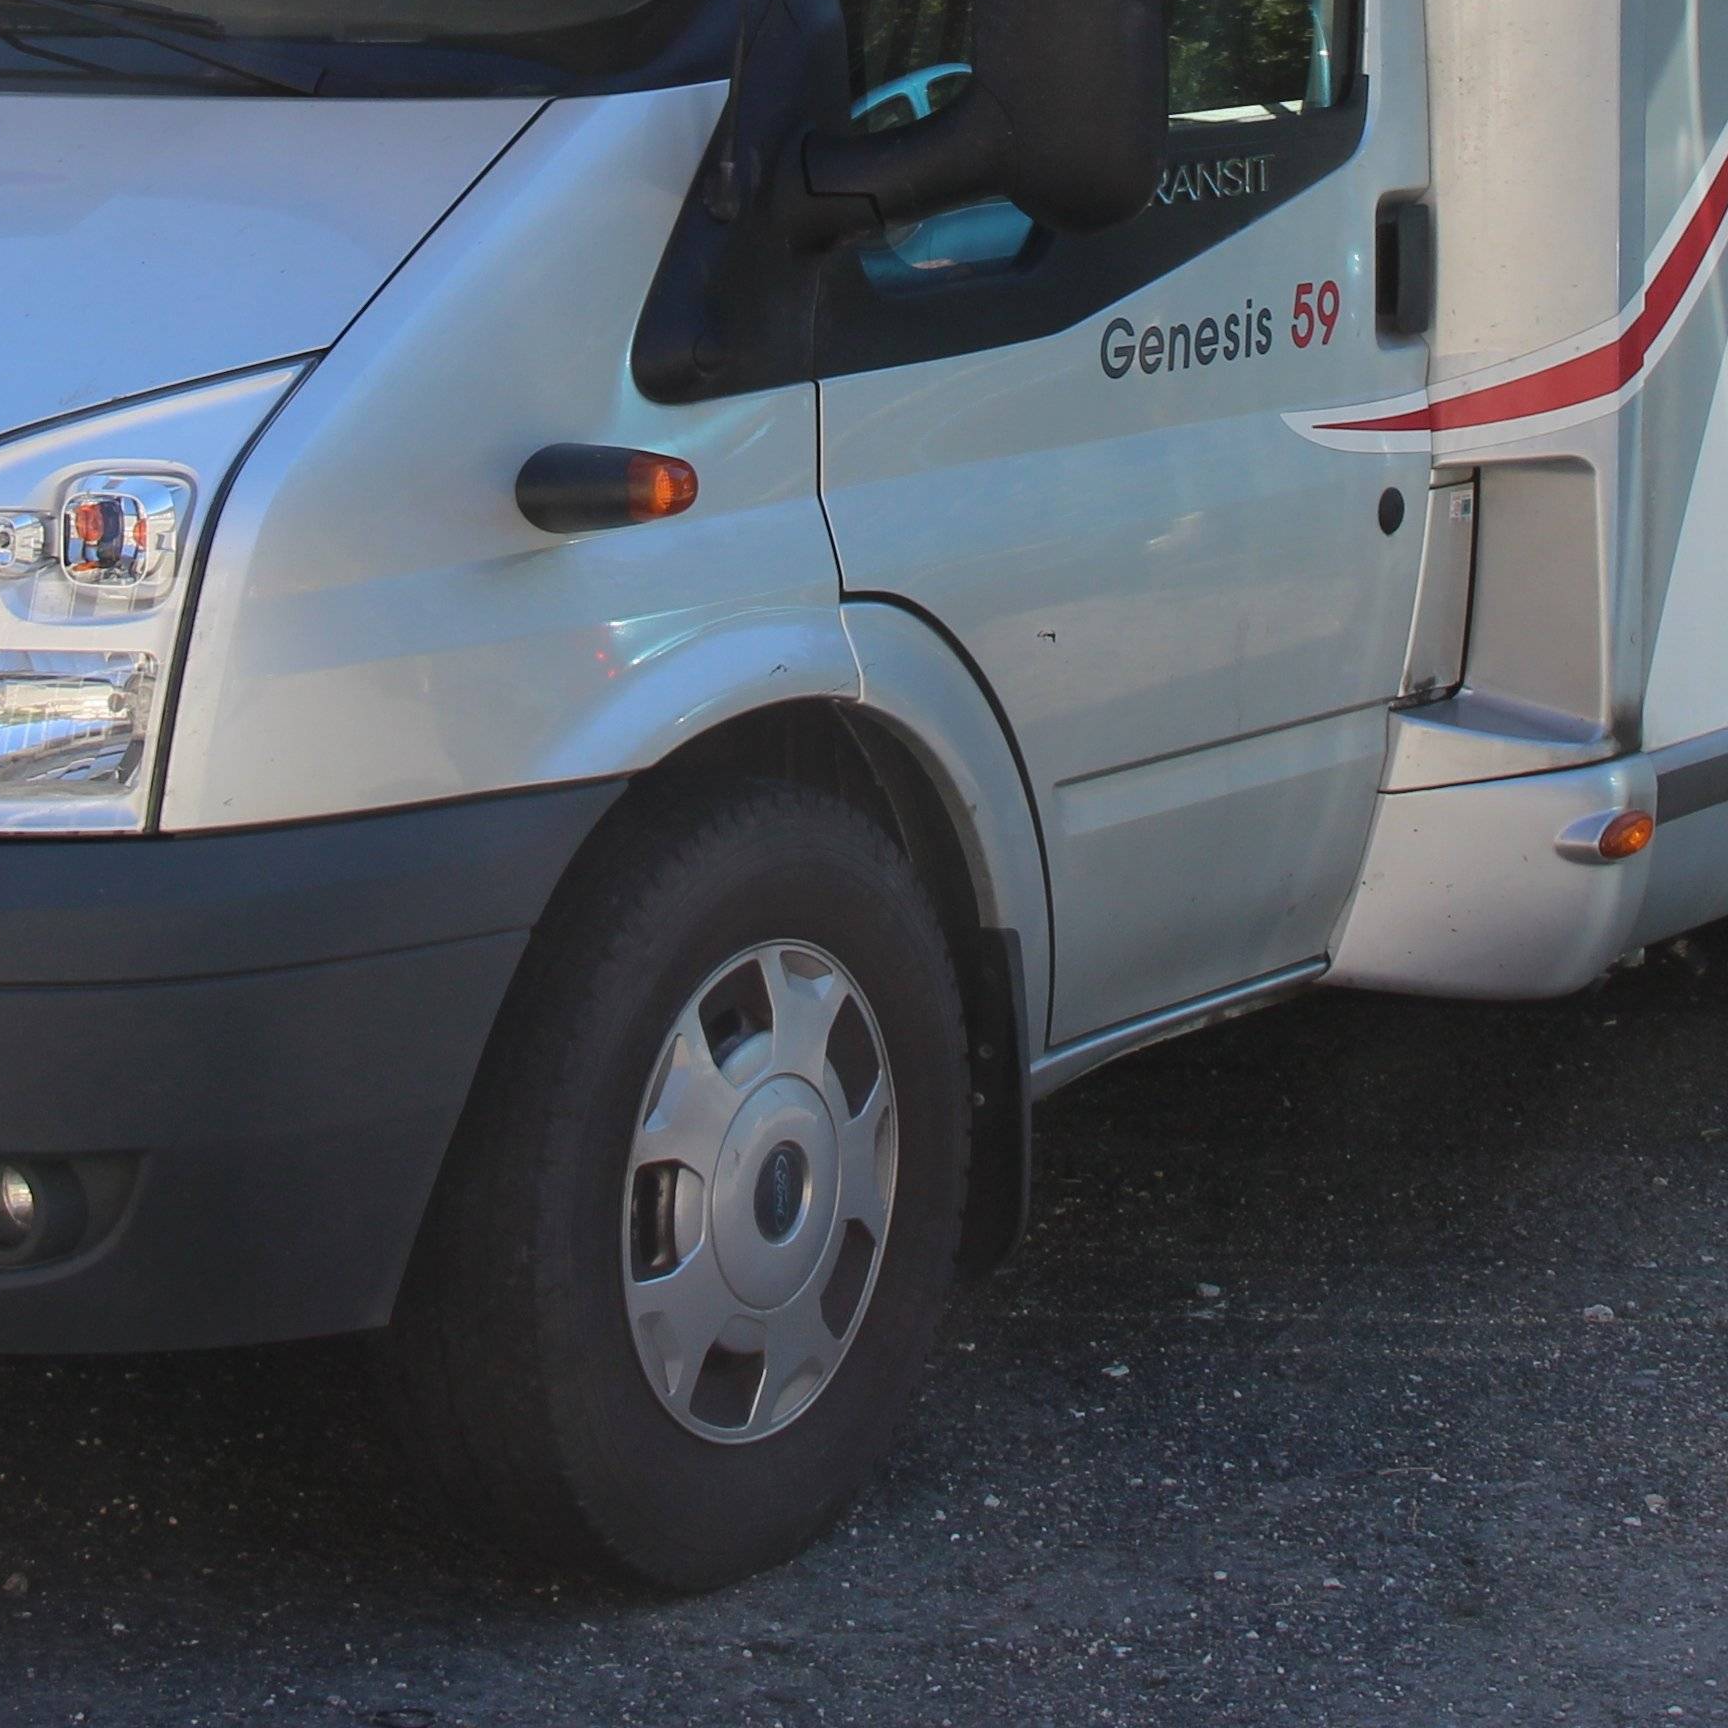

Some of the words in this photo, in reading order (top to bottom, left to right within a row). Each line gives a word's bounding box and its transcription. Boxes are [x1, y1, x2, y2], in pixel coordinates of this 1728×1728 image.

[1155, 153, 1276, 204] RANSIT
[1100, 298, 1273, 379] Genesis
[1291, 280, 1340, 349] 59
